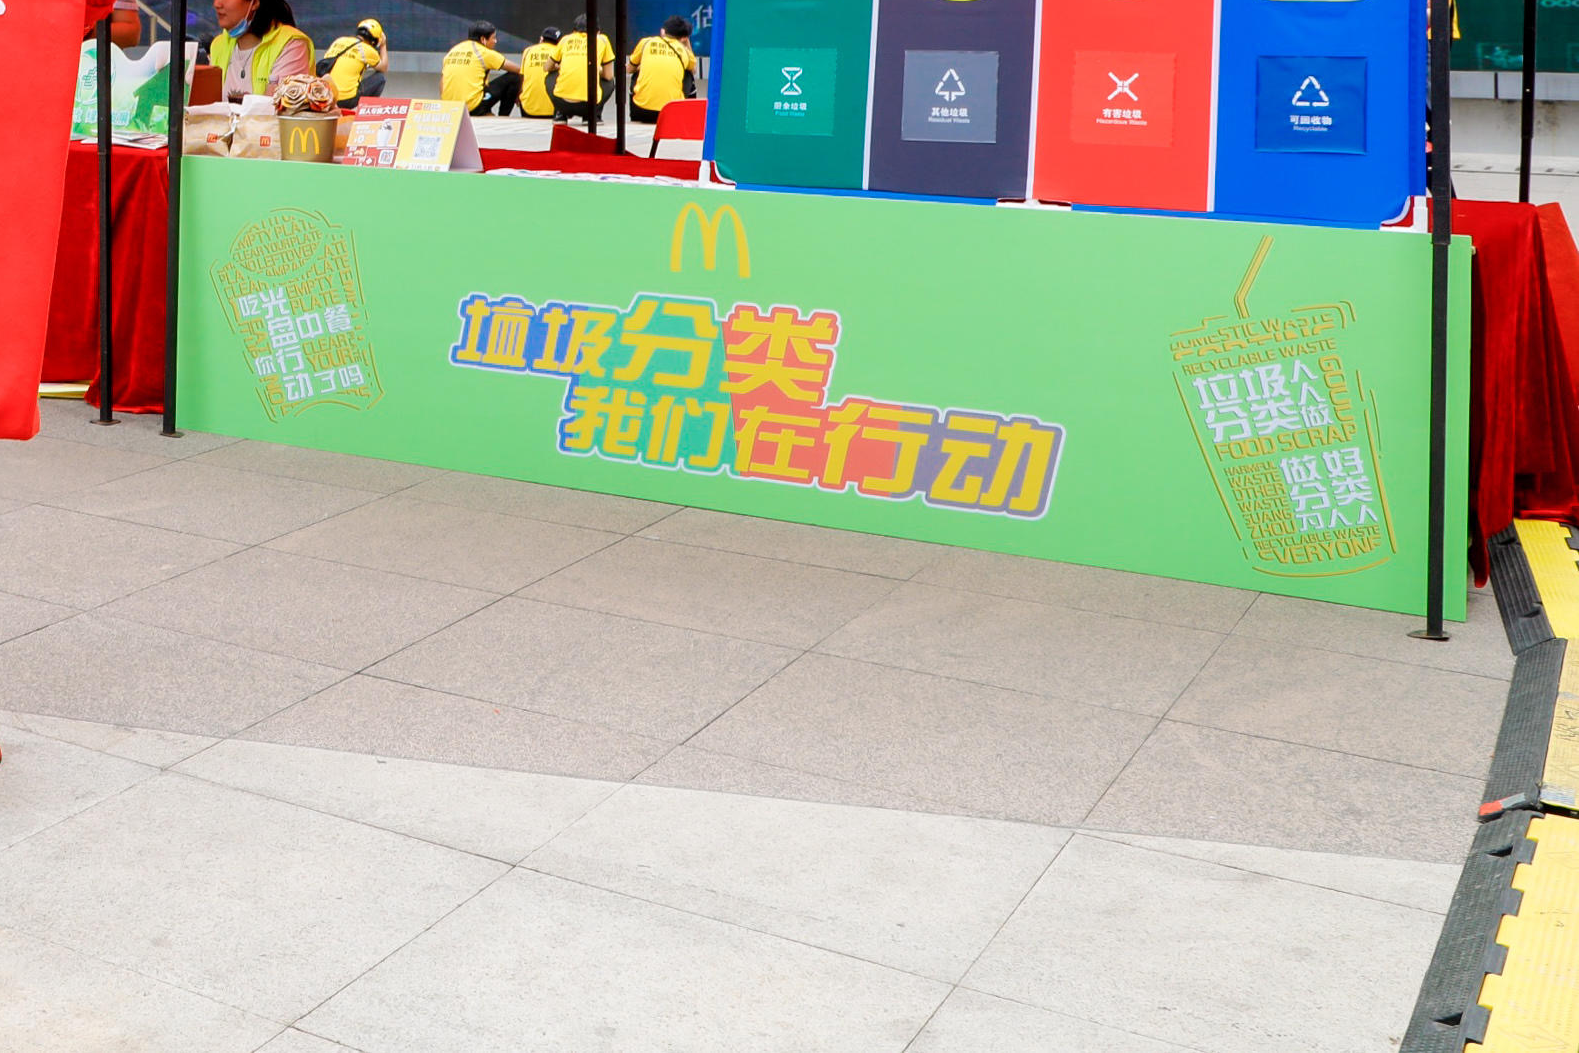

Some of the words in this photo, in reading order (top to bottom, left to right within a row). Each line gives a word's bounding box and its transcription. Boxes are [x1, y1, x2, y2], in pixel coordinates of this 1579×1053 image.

[773, 101, 808, 112] 厨余垃圾
[931, 106, 969, 118] 其他垃圾
[1102, 108, 1143, 120] 有害垃圾
[1289, 114, 1333, 126] 可回收物
[286, 273, 334, 300] EMPTY
[238, 286, 290, 319] 吃光
[291, 289, 341, 315] PLATE
[267, 303, 352, 348] 盘中餐
[456, 298, 836, 403] 垃圾分类
[1182, 347, 1278, 376] RECYCLABLE
[1279, 337, 1338, 359] WASTE
[1192, 362, 1292, 410] 垃圾
[1205, 396, 1303, 444] 分类
[564, 386, 1055, 512] 我们在行动
[1214, 436, 1278, 462] FOOD
[1277, 422, 1358, 452] SCRAP
[1227, 469, 1283, 489] WASTE
[1279, 445, 1365, 485] 做好
[1232, 481, 1287, 502] OTHER
[1237, 495, 1290, 514] WASTE
[1288, 474, 1374, 513] 分类
[1250, 519, 1298, 541] ZHOU
[1295, 503, 1379, 532] 为人人
[1253, 530, 1332, 550] RECYCLABLE
[1333, 523, 1380, 541] WASTE
